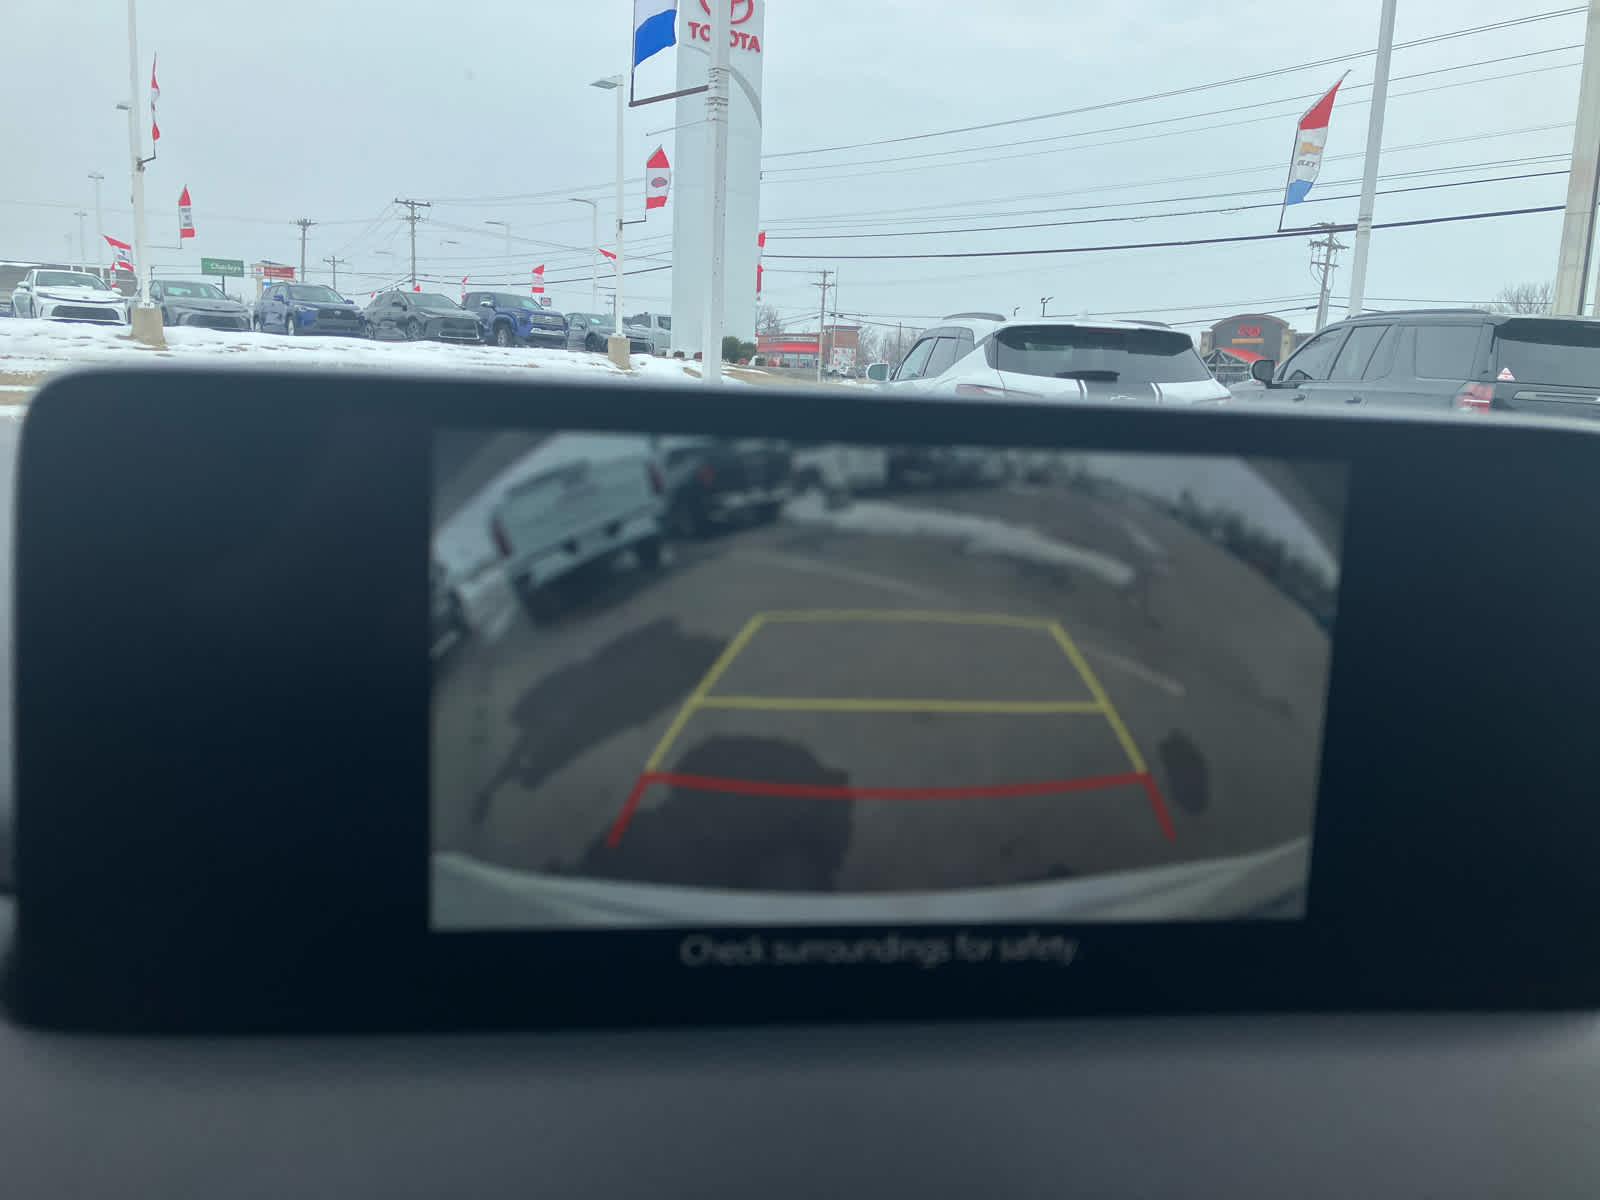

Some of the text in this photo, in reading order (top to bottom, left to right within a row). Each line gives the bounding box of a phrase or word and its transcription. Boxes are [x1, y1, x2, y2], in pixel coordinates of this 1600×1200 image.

[688, 22, 760, 53] TOOTA
[681, 933, 764, 966] Check
[774, 933, 951, 968] surroundings
[955, 931, 993, 962] for
